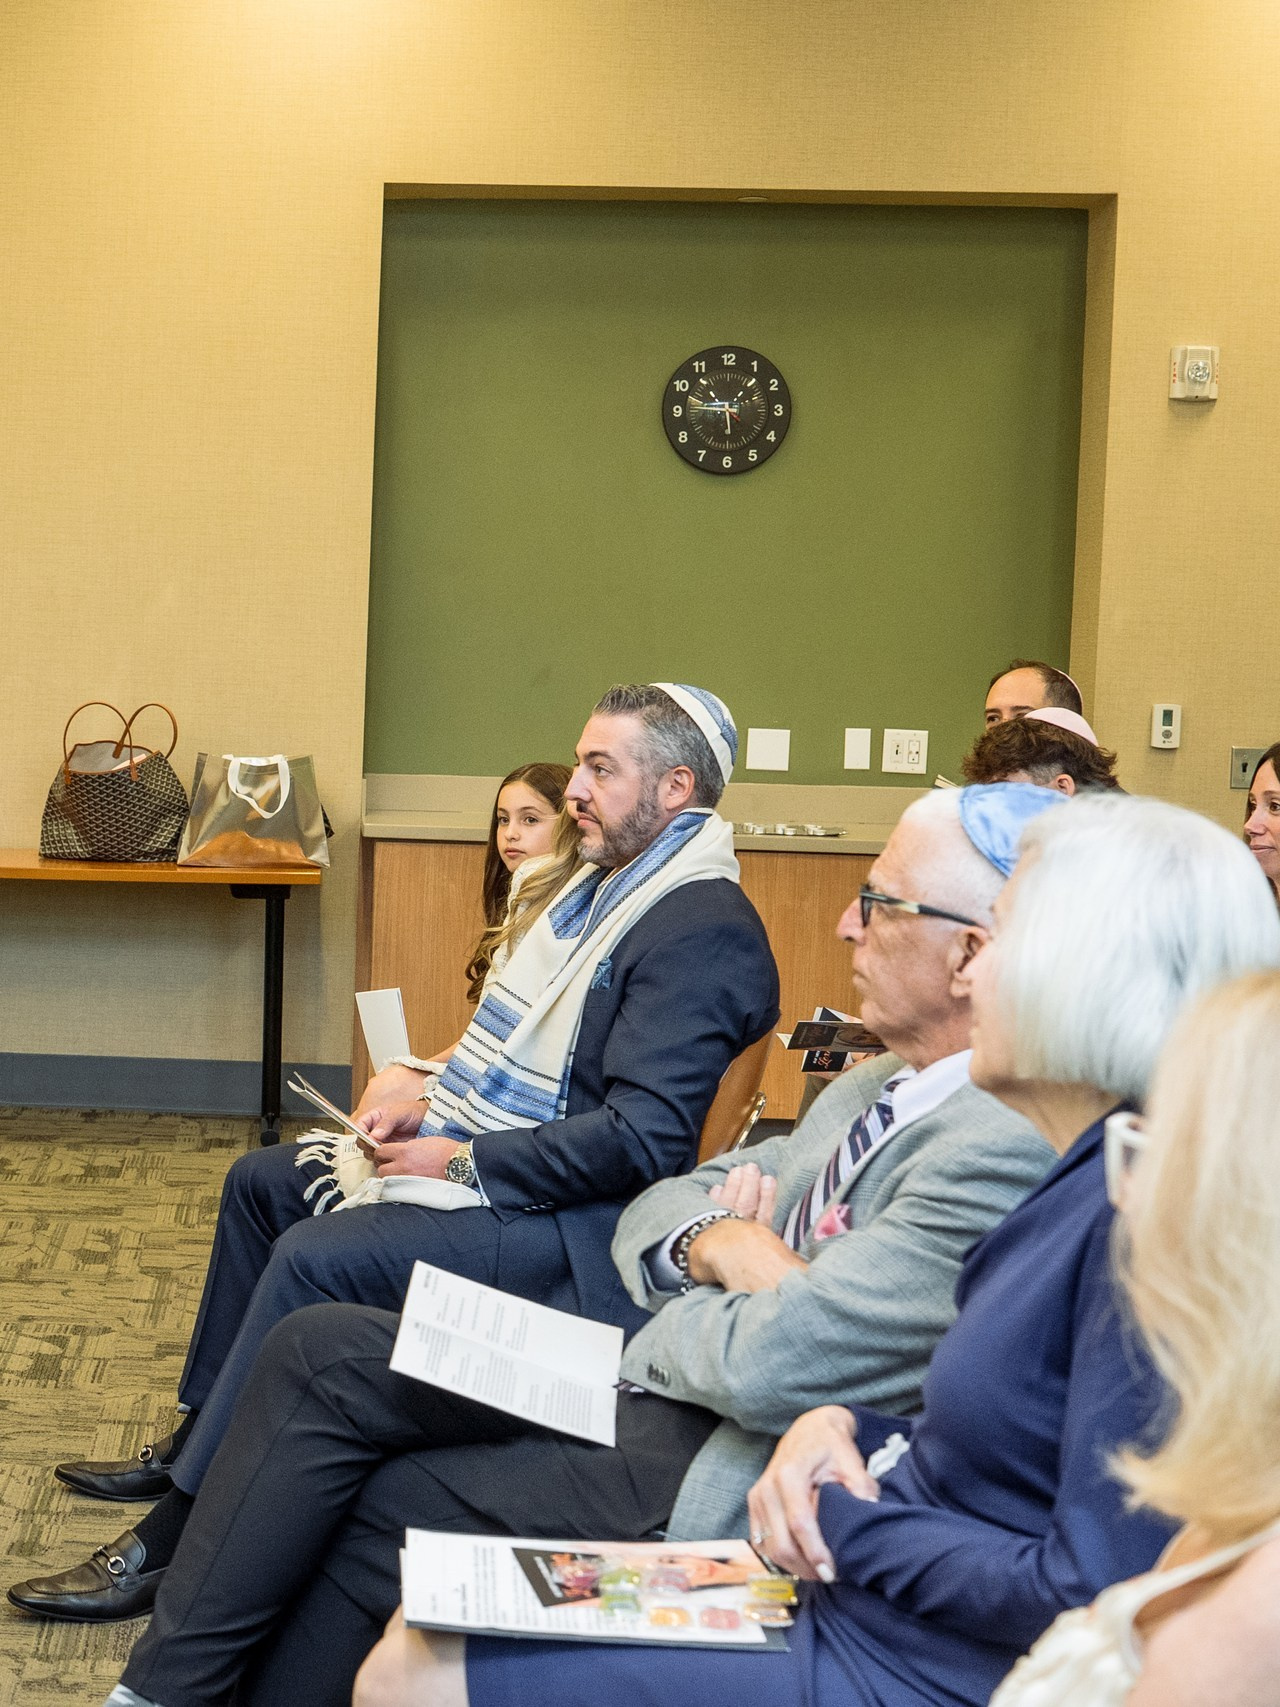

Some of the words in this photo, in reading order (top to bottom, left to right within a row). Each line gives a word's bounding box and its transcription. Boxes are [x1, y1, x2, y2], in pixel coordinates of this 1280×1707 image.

[722, 354, 735, 365] 12
[693, 361, 705, 372] 11
[751, 361, 757, 372] 1
[674, 380, 689, 391] 10
[770, 379, 778, 390] 2
[673, 405, 682, 417] 9
[774, 404, 783, 416] 3
[679, 431, 687, 443] 8
[766, 431, 776, 442] 4
[698, 450, 706, 461] 7
[748, 450, 757, 461] 5
[723, 456, 732, 468] 6
